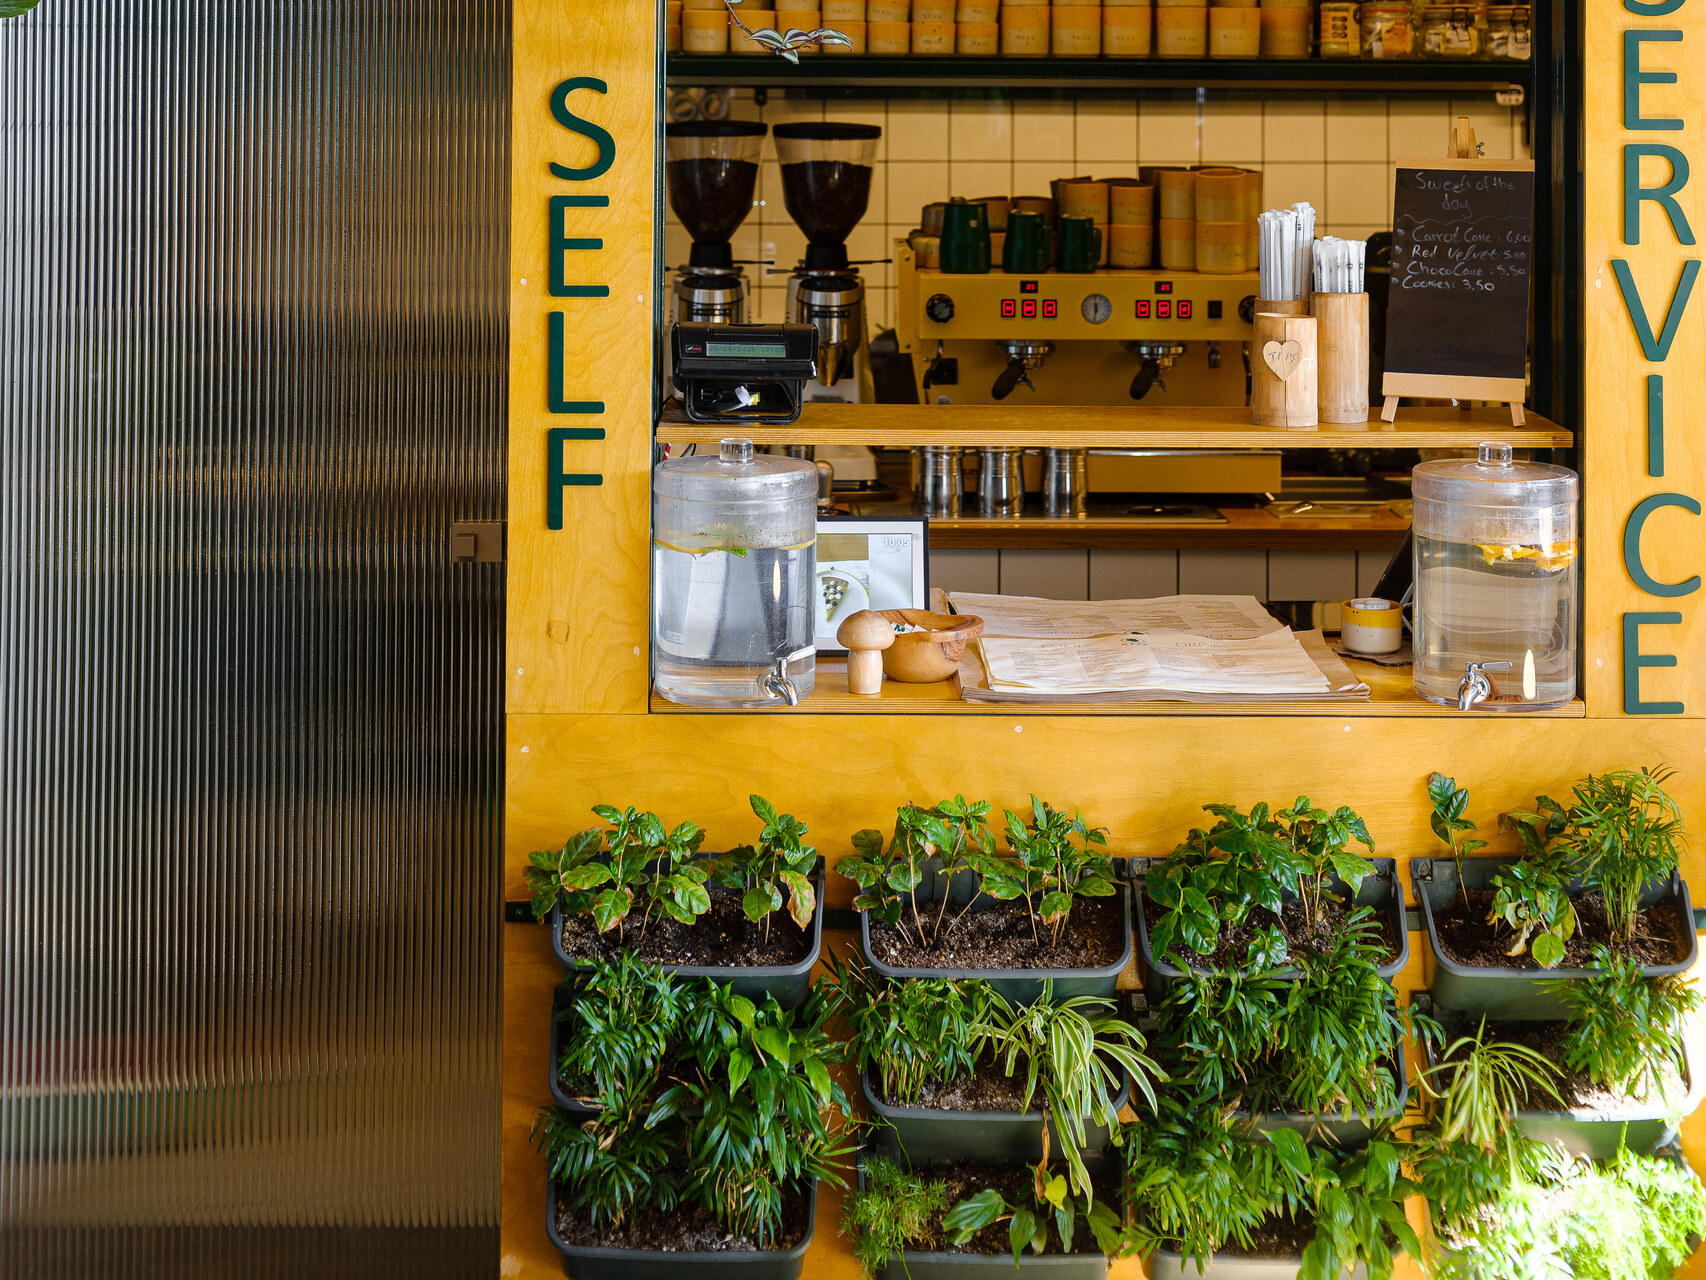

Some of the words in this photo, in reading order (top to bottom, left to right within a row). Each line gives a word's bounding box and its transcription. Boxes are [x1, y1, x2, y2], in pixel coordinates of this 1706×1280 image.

[1415, 172, 1471, 193] Sweets
[1475, 176, 1489, 191] of
[1491, 176, 1516, 190] the
[1441, 193, 1473, 219] day
[1411, 225, 1459, 243] Carrot
[1411, 244, 1438, 258] Red
[548, 76, 616, 531] SELF
